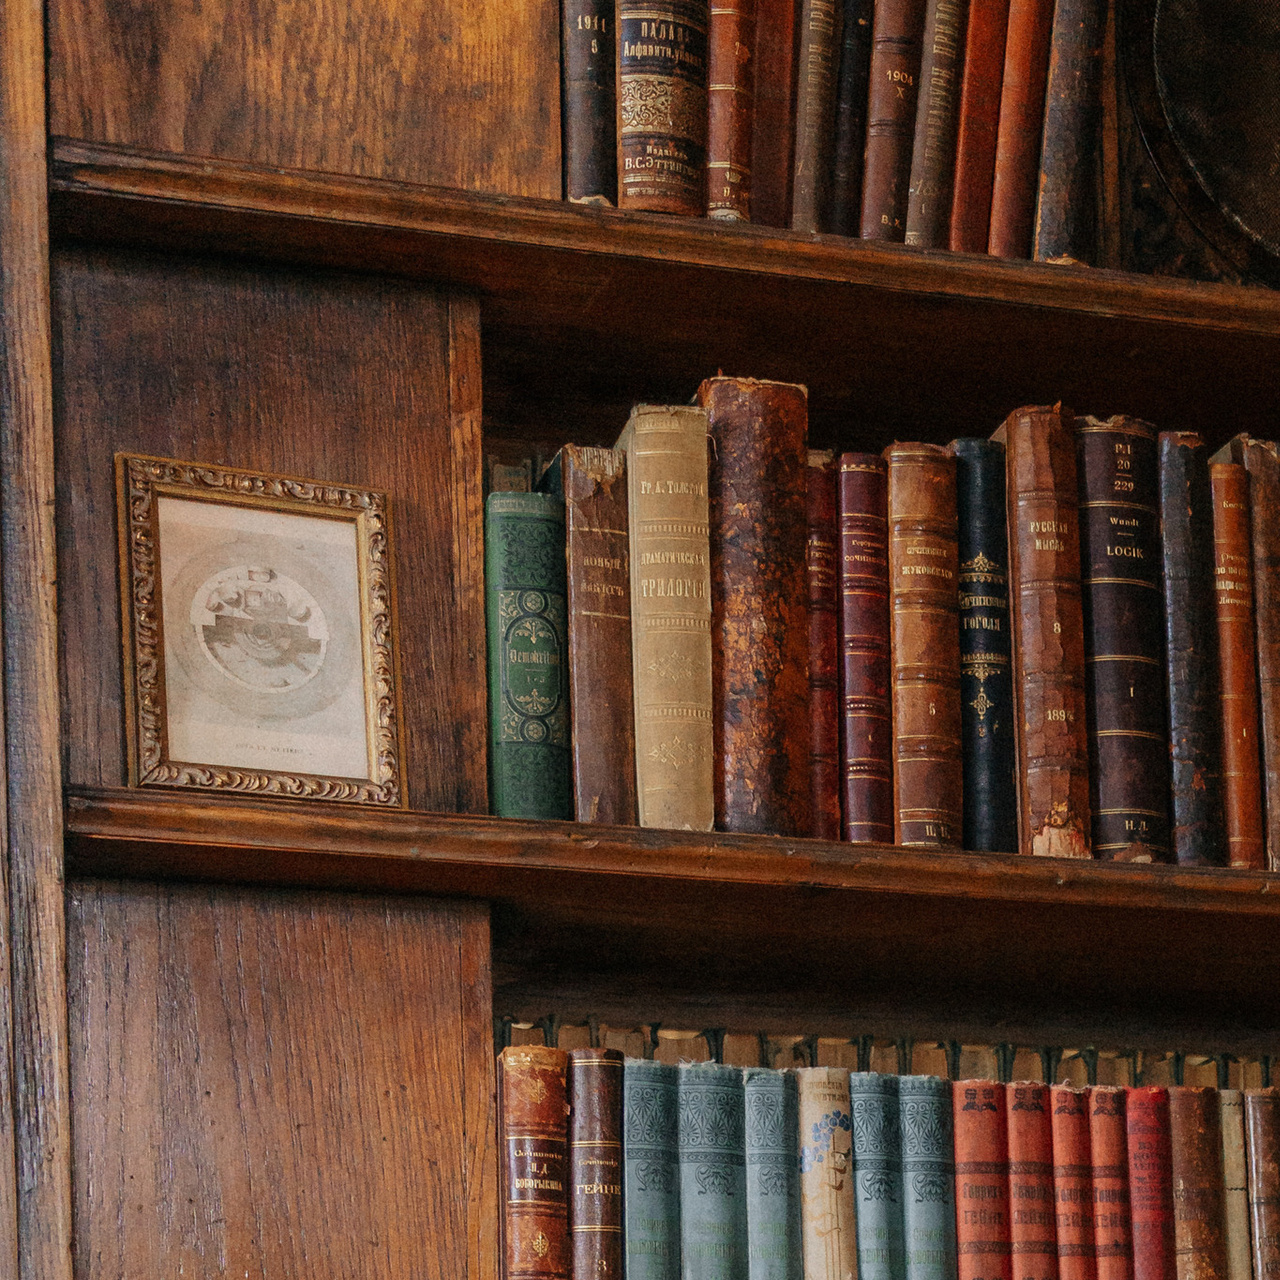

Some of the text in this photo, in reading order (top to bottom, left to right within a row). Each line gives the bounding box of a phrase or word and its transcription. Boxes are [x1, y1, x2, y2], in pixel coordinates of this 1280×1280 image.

[886, 70, 913, 86] 1904
[1114, 481, 1134, 492] 229
[1110, 517, 1139, 527] Wundt
[1106, 546, 1144, 559] LOGIK
[597, 1259, 607, 1272] 3
